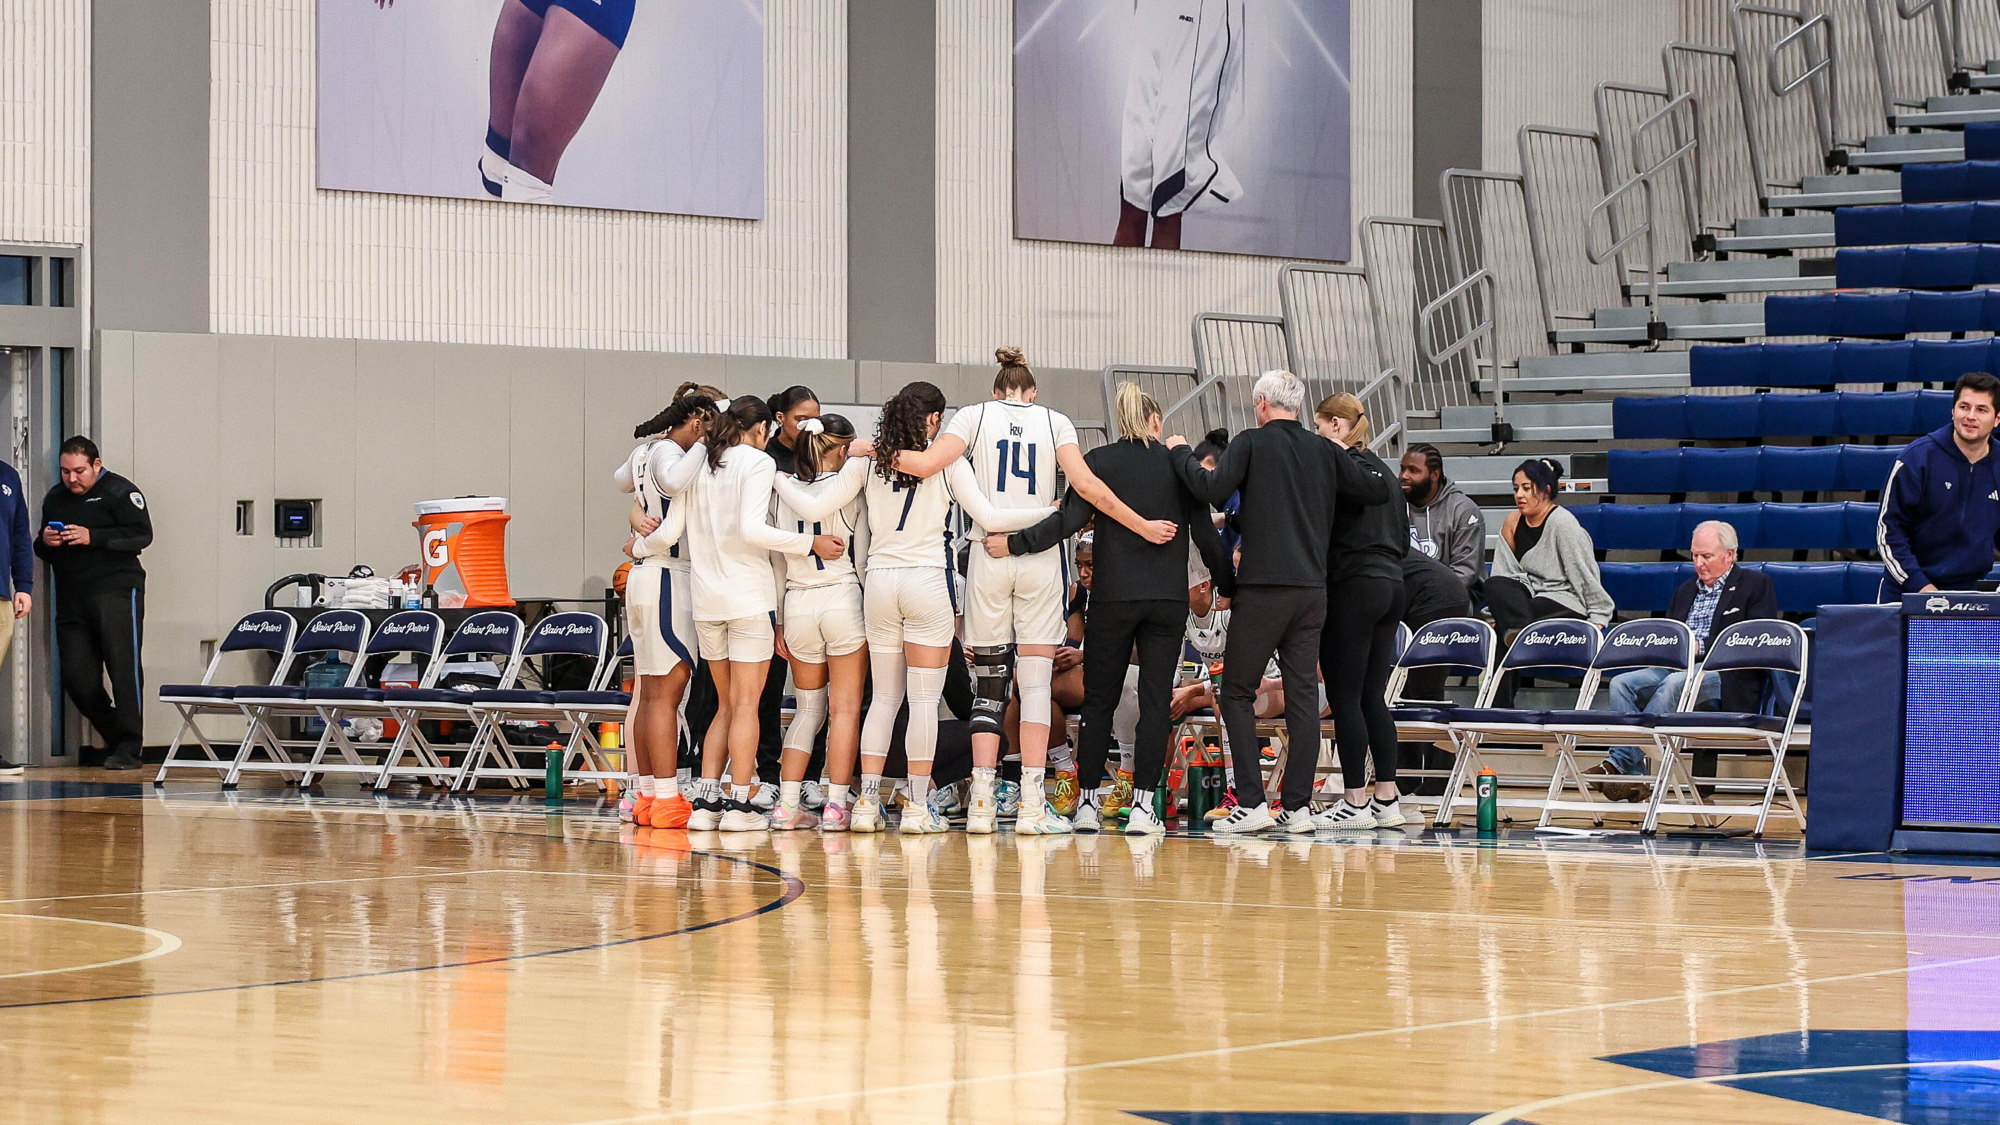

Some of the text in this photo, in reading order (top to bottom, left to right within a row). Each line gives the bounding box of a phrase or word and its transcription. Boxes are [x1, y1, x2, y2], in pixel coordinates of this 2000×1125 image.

[996, 439, 1036, 496] 14
[422, 528, 450, 568] G
[237, 620, 259, 632] Saint
[310, 620, 333, 632] Saint
[382, 622, 406, 634] Saint
[462, 622, 485, 634] Saint
[540, 622, 565, 636] Saint
[1418, 631, 1450, 645] Saint
[1523, 631, 1555, 645] Saint
[1612, 632, 1645, 647] Saint
[1724, 632, 1757, 647] Saint
[1479, 784, 1491, 797] G
